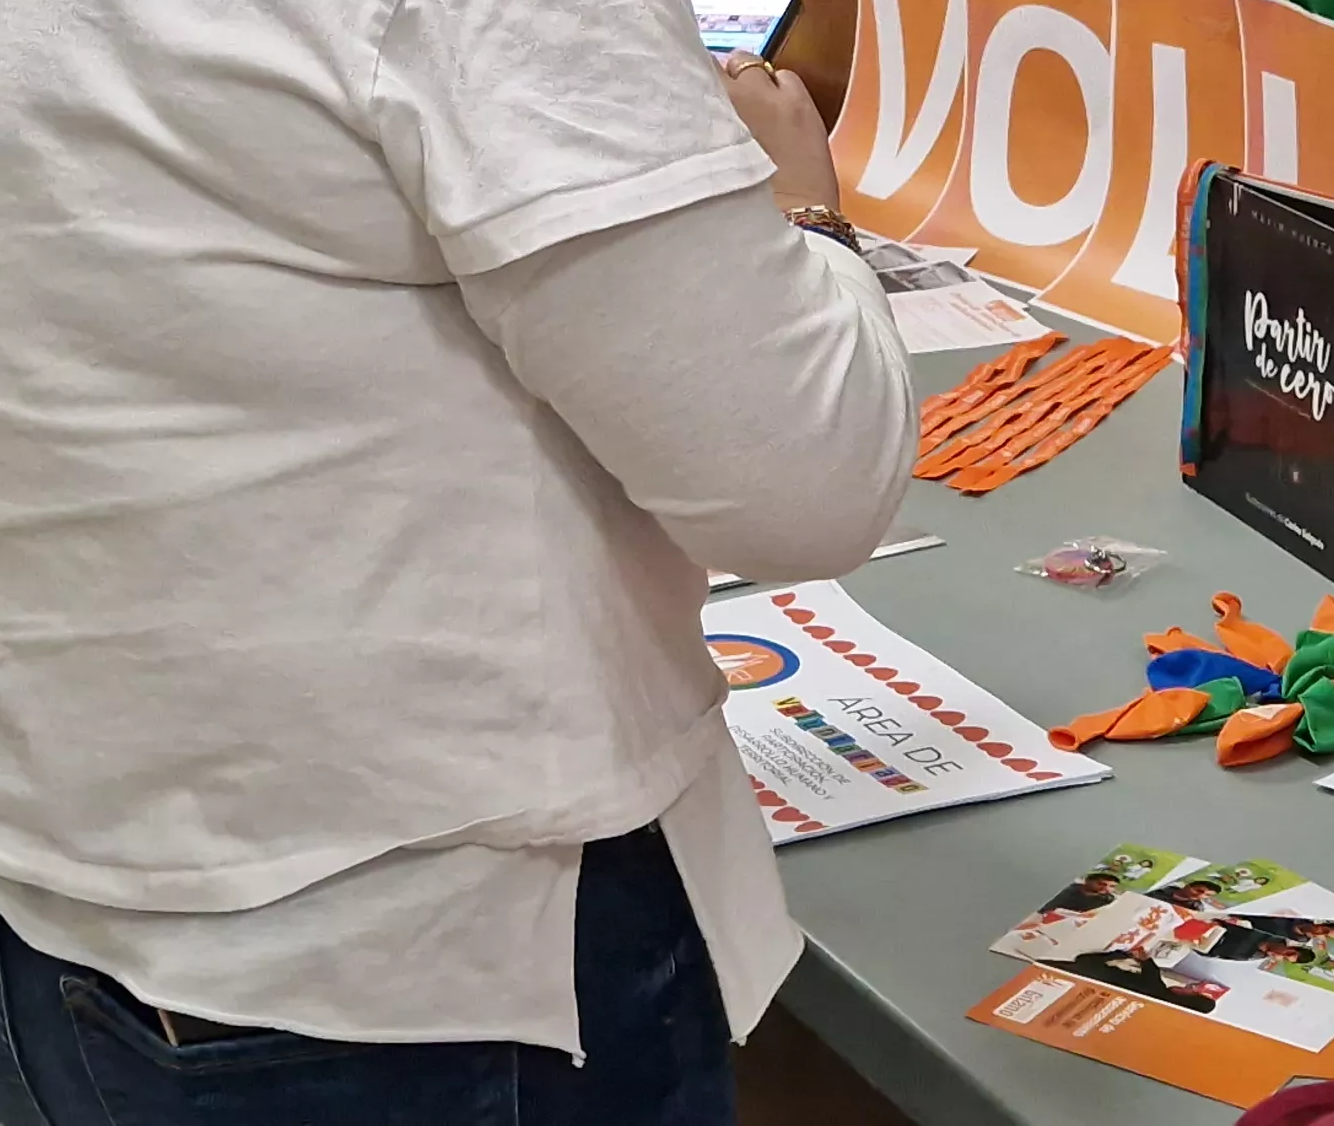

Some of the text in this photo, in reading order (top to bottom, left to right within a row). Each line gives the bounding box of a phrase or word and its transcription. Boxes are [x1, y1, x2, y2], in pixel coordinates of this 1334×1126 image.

[1244, 290, 1331, 373] Partir
[1255, 342, 1278, 378] de
[903, 746, 963, 777] DE
